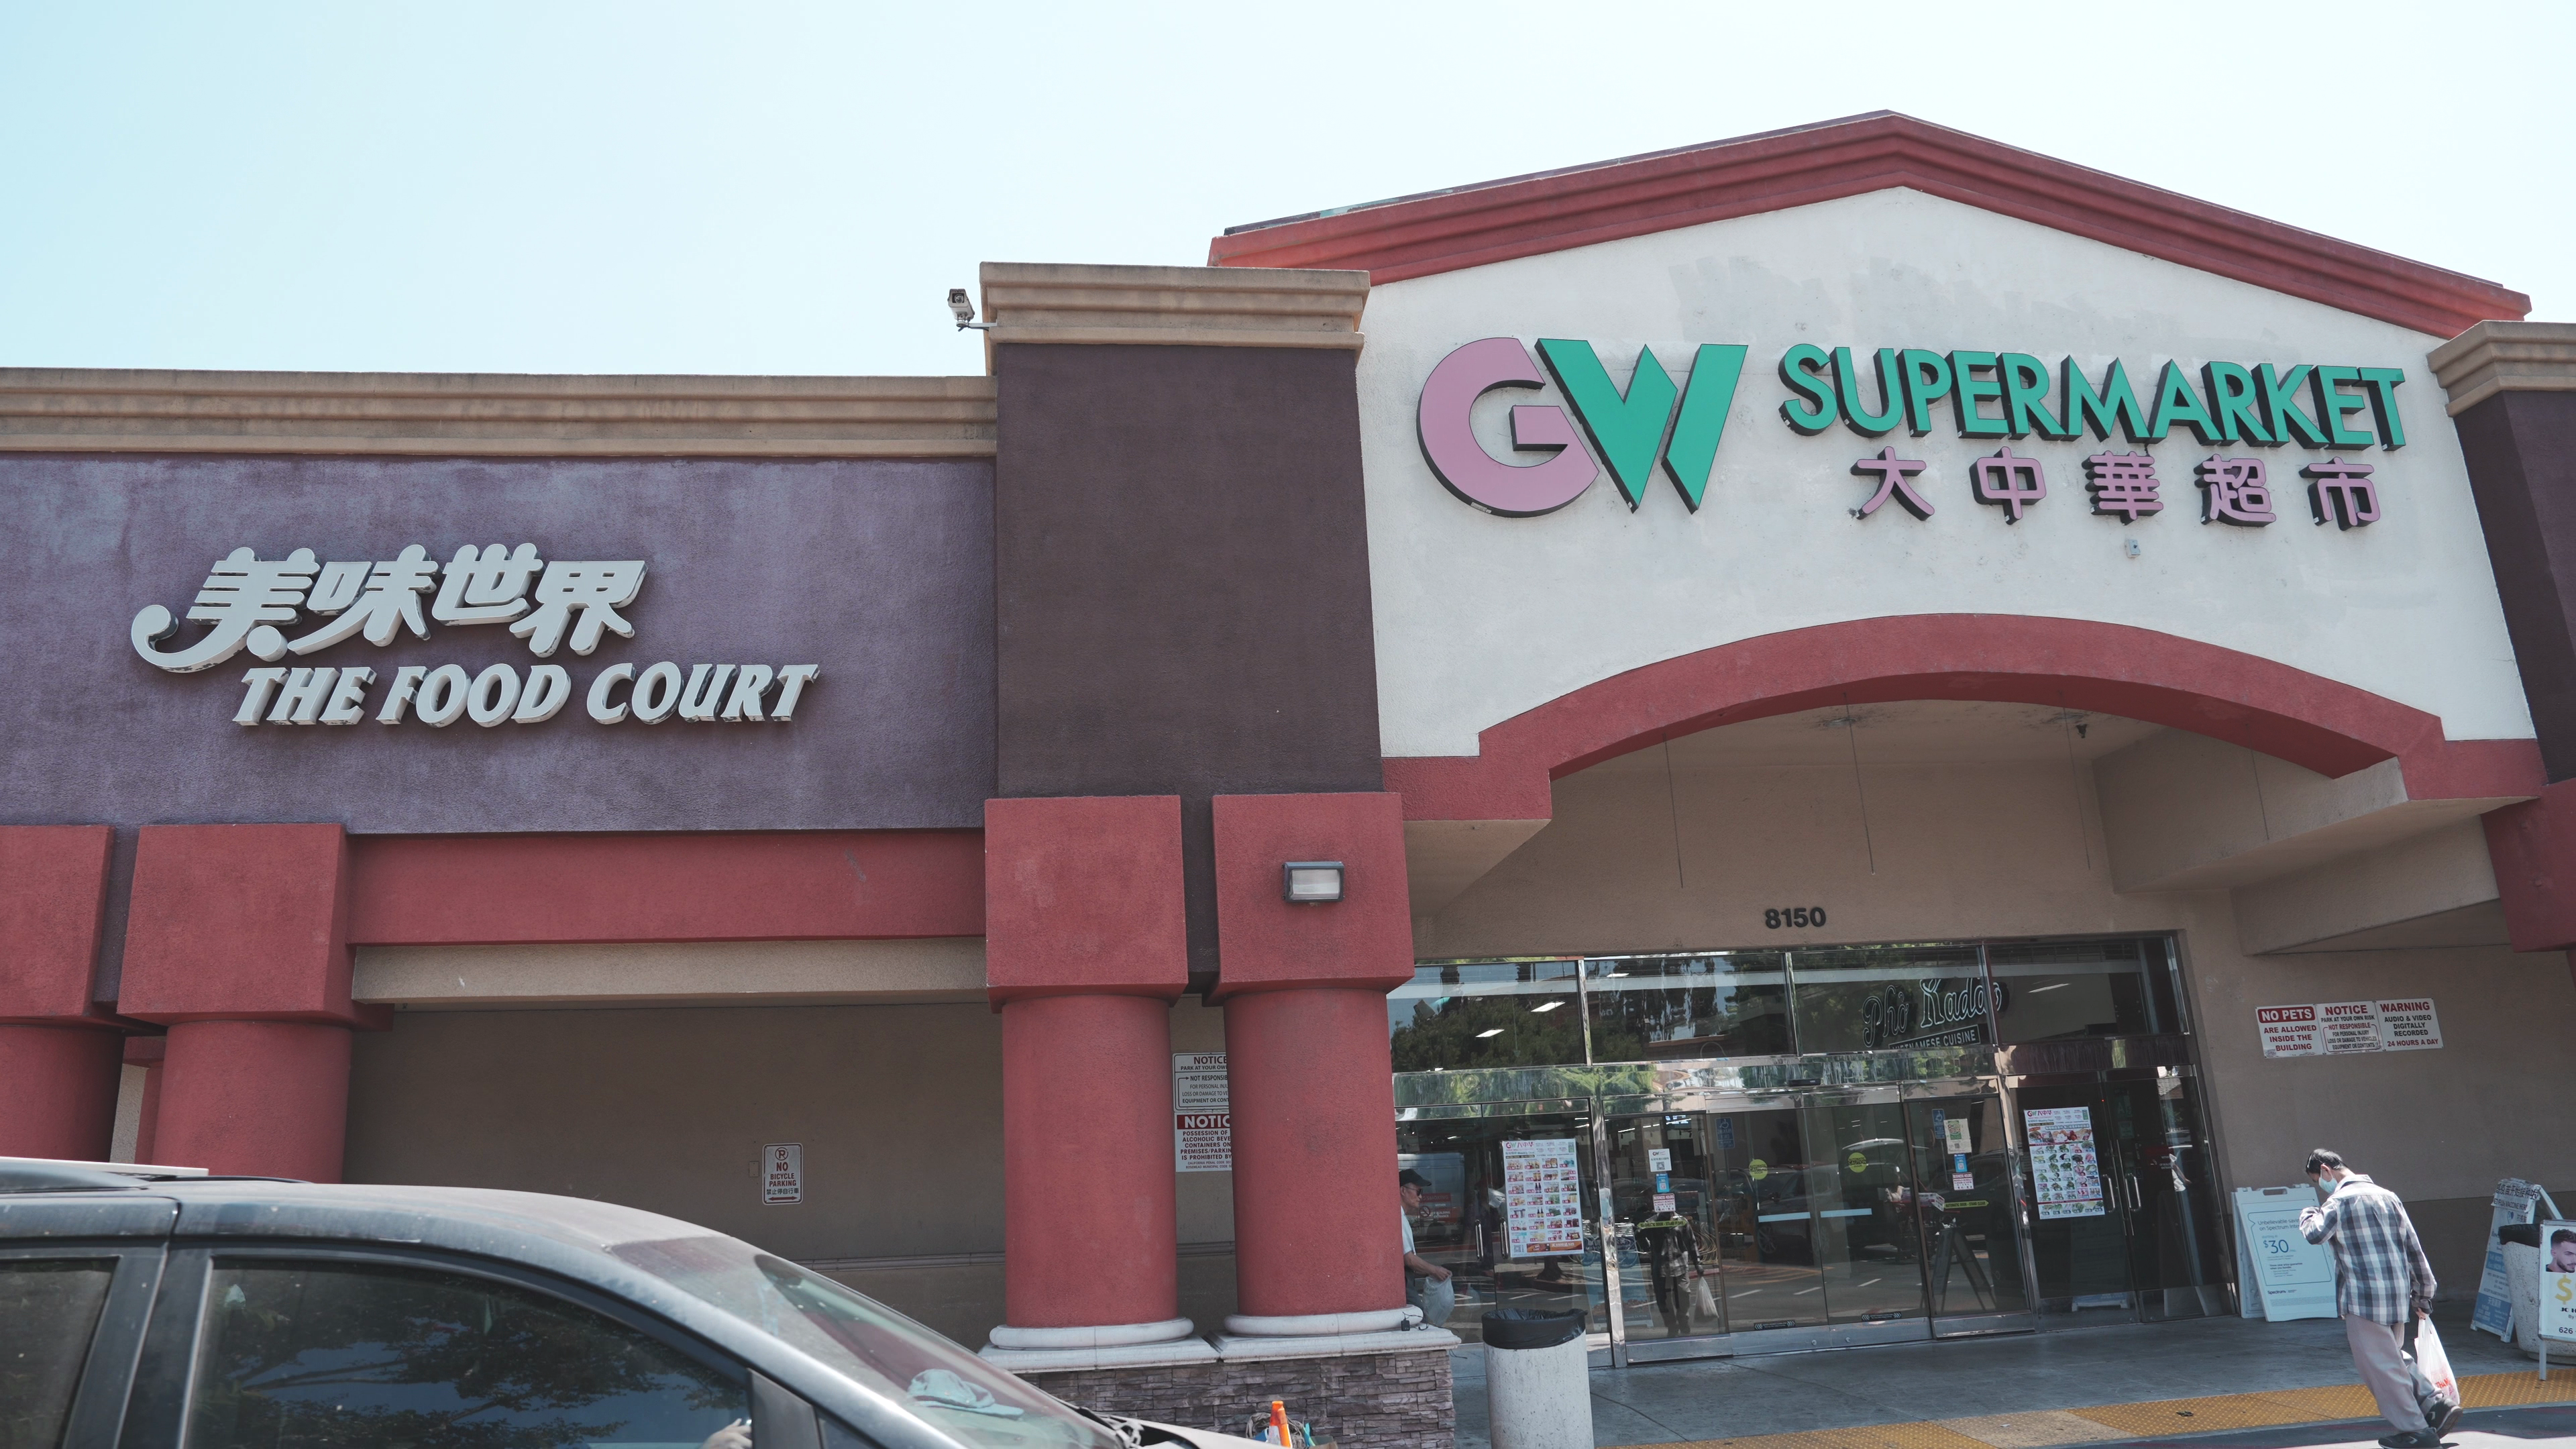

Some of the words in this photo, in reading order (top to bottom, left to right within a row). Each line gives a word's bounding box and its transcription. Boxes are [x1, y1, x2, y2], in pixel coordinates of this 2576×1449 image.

[1778, 343, 2407, 451] SUPERMARKET
[1416, 337, 1748, 517] GW
[1849, 446, 2381, 531] 大中華超市
[131, 543, 649, 673] 美味世界
[233, 667, 378, 726] THE
[376, 663, 572, 728] FOOD
[586, 661, 819, 725] COURT
[1765, 907, 1826, 929] 8150
[2324, 1005, 2368, 1016] NOTICE
[2380, 1002, 2430, 1012] WARNING
[2261, 1010, 2279, 1022] NO
[2282, 1008, 2312, 1020] PETS
[2281, 1024, 2317, 1033] ALLOWED
[2394, 1029, 2428, 1037] RECORDED
[1943, 1029, 1976, 1046] CUISINE
[2275, 1043, 2312, 1051] BUILDING
[776, 1162, 788, 1171] NO
[2263, 1239, 2289, 1254] $30
